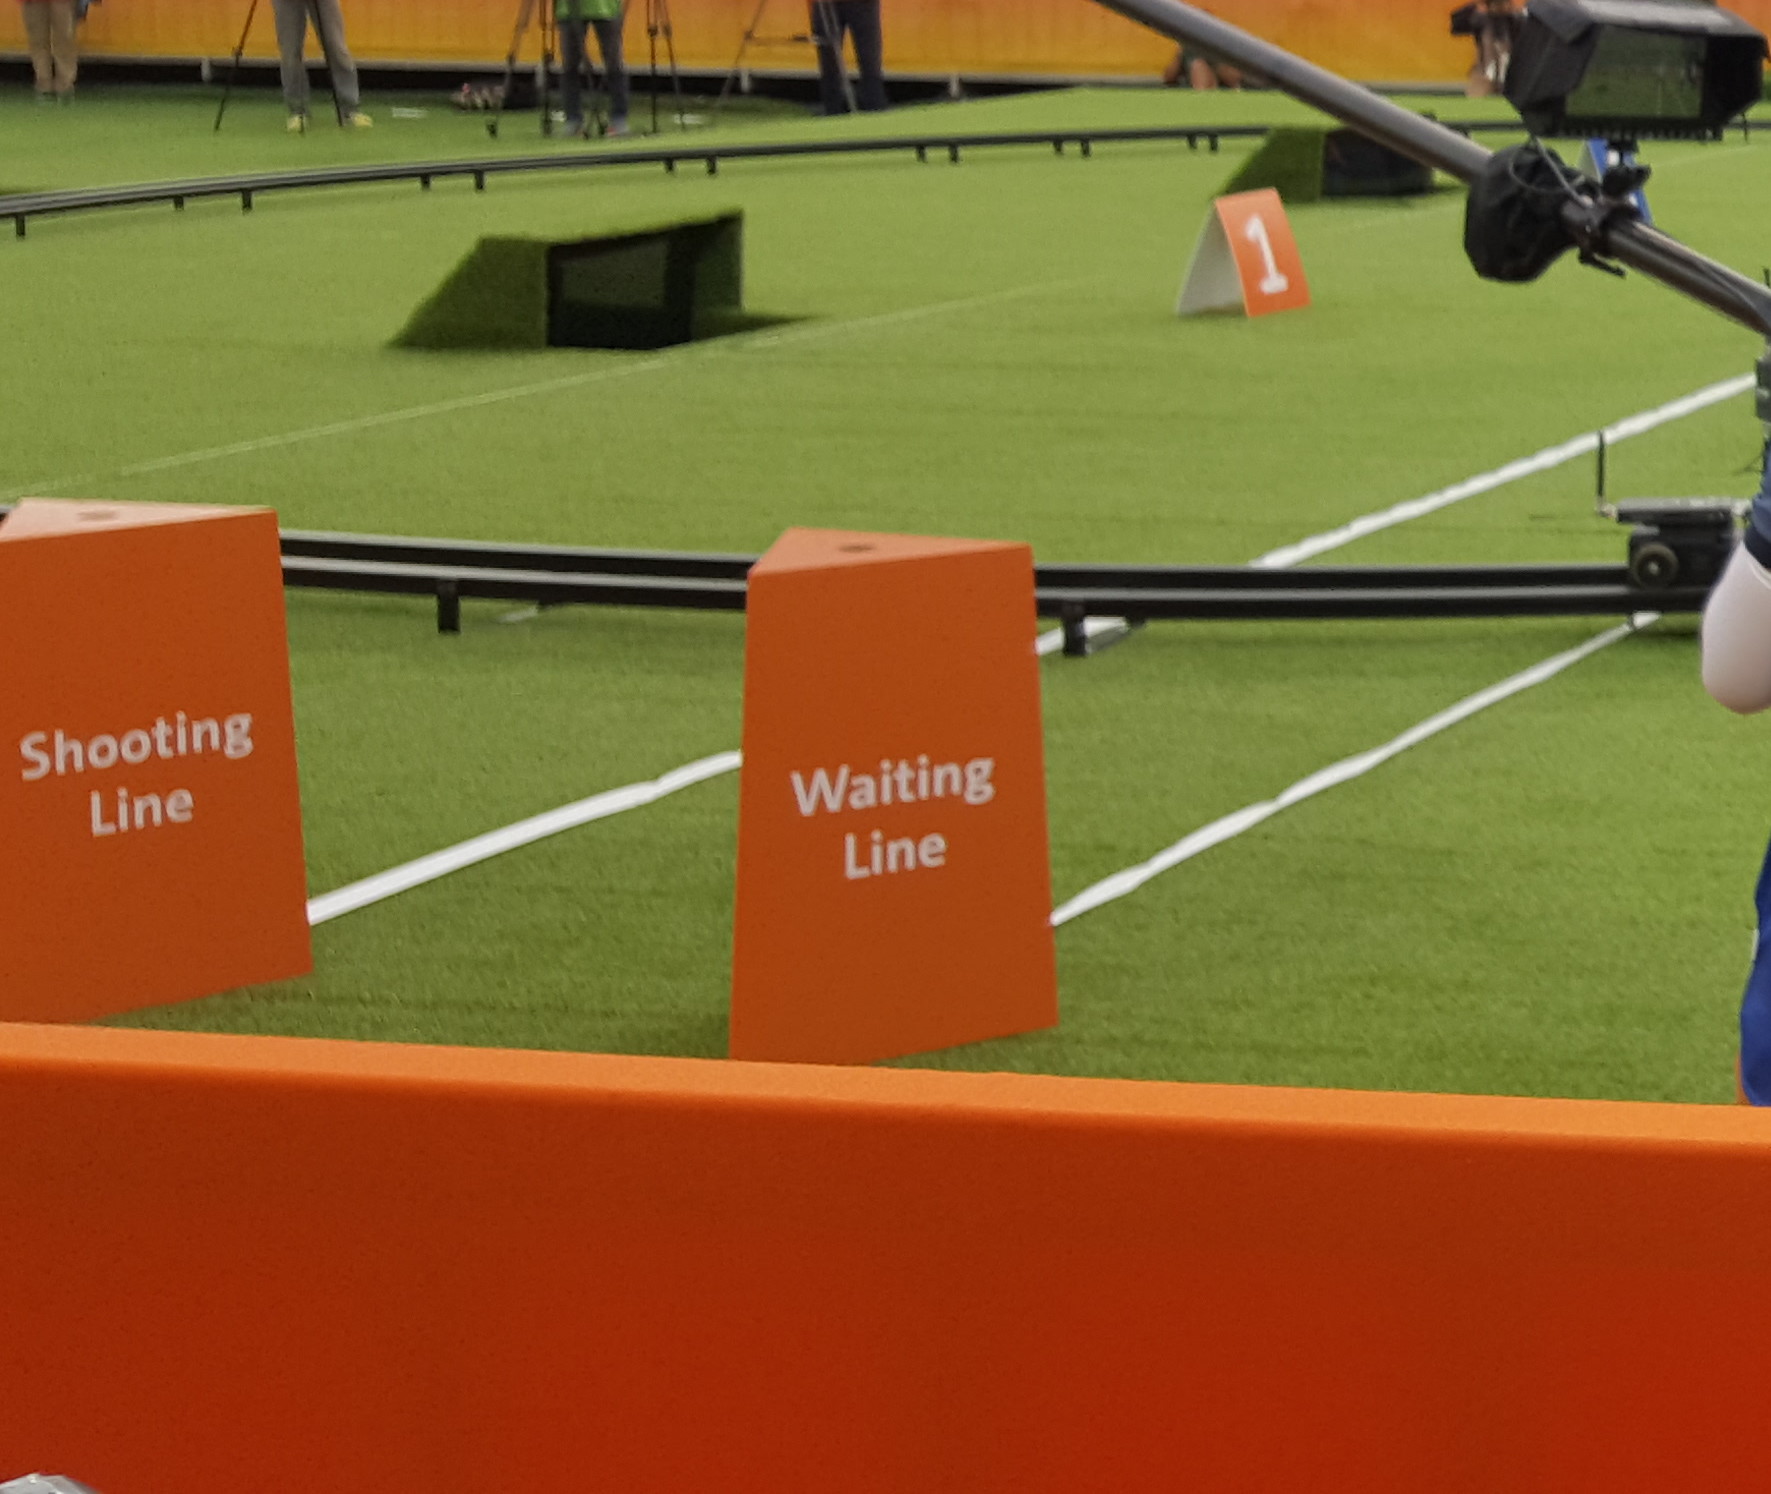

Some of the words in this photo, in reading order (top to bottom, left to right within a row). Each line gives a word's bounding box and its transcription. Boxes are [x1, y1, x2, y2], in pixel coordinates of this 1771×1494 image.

[1244, 214, 1288, 294] 1
[20, 710, 254, 781] Shooting
[90, 787, 194, 838] Line
[790, 754, 996, 818] Waiting
[843, 828, 948, 880] Line
